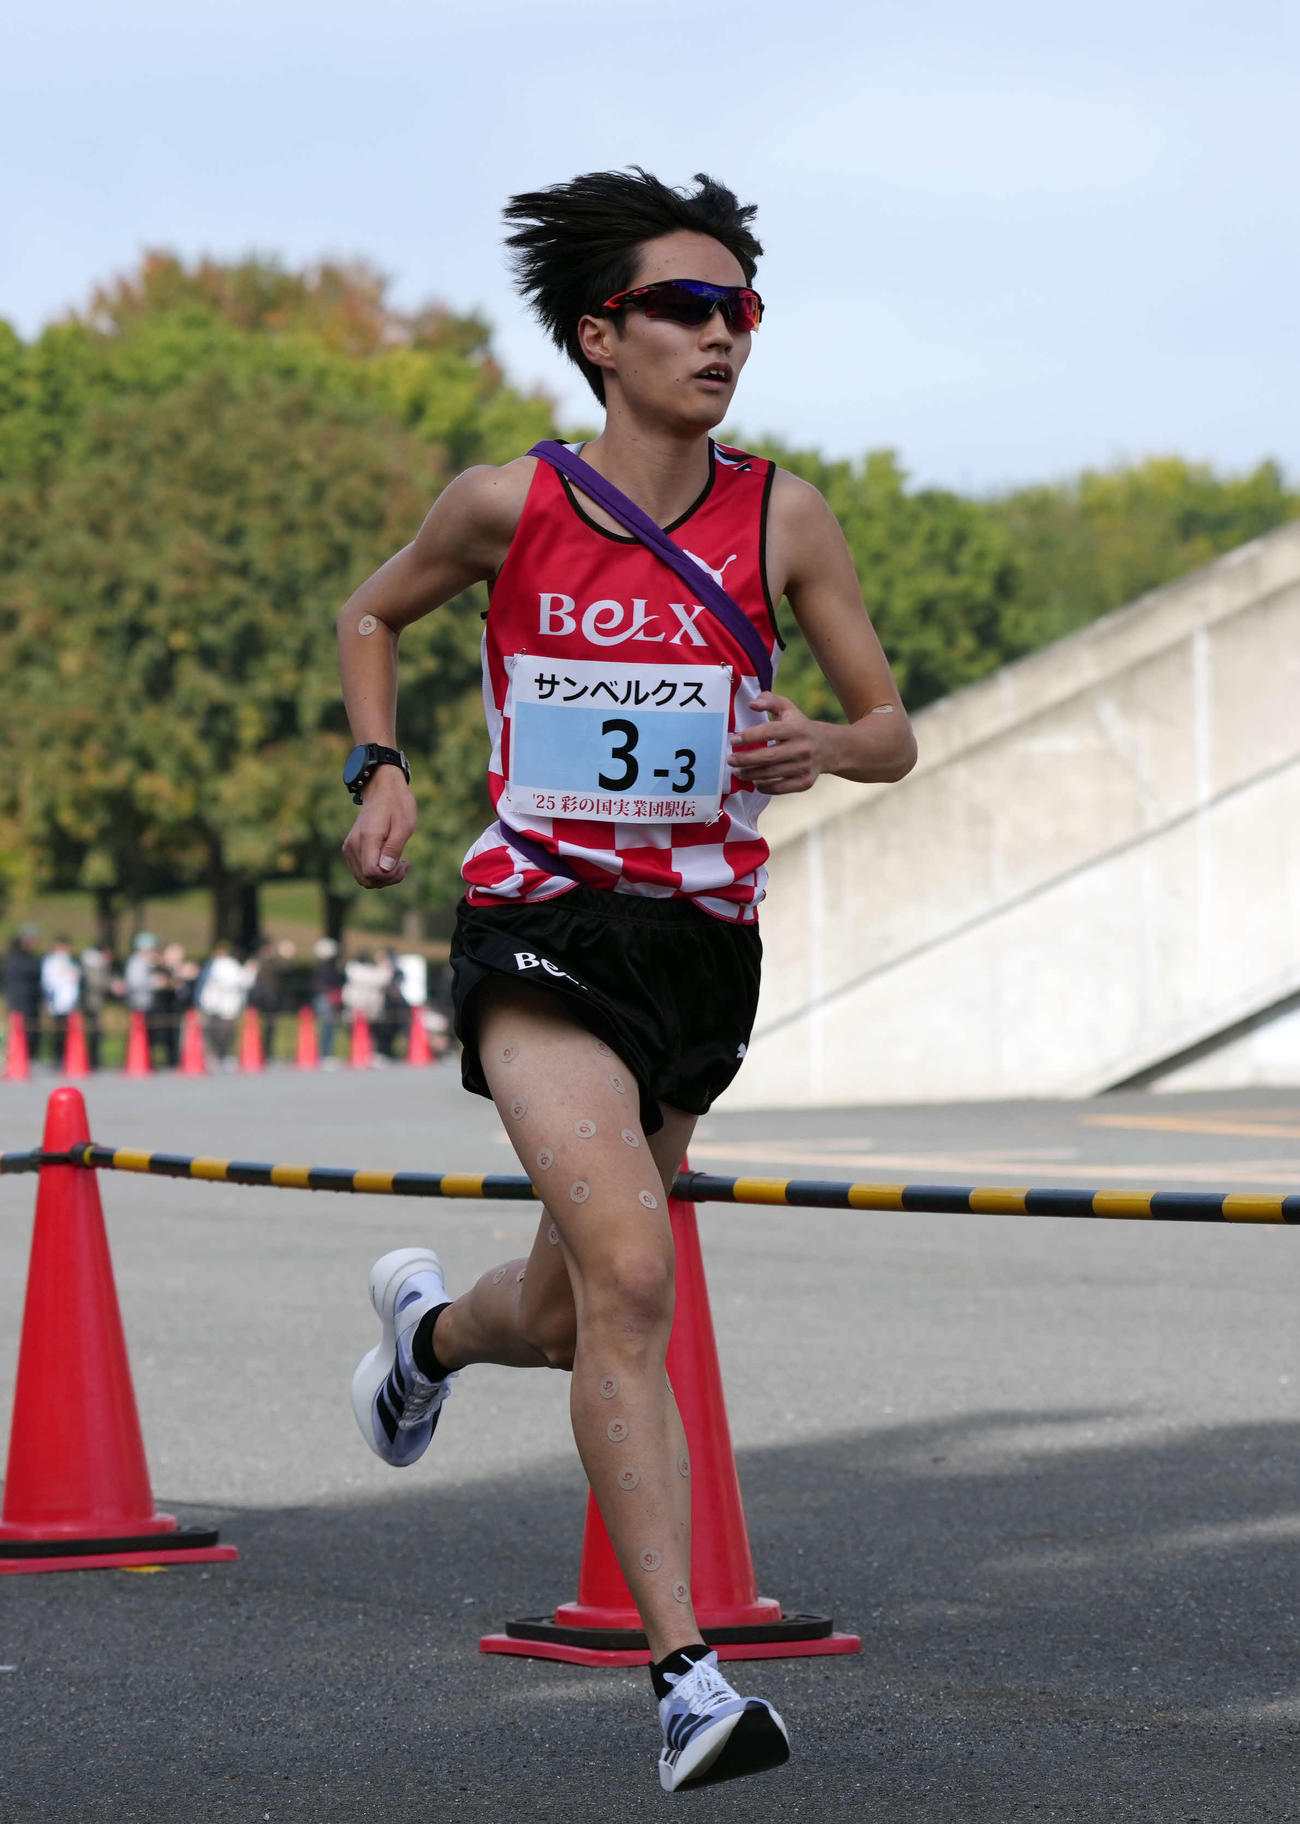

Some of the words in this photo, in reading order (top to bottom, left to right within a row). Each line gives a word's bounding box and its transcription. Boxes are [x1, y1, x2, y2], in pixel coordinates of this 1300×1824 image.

[534, 673, 707, 707] サンベルクス
[561, 795, 696, 817] 彩の国実業団駅伝
[513, 952, 589, 991] Be
